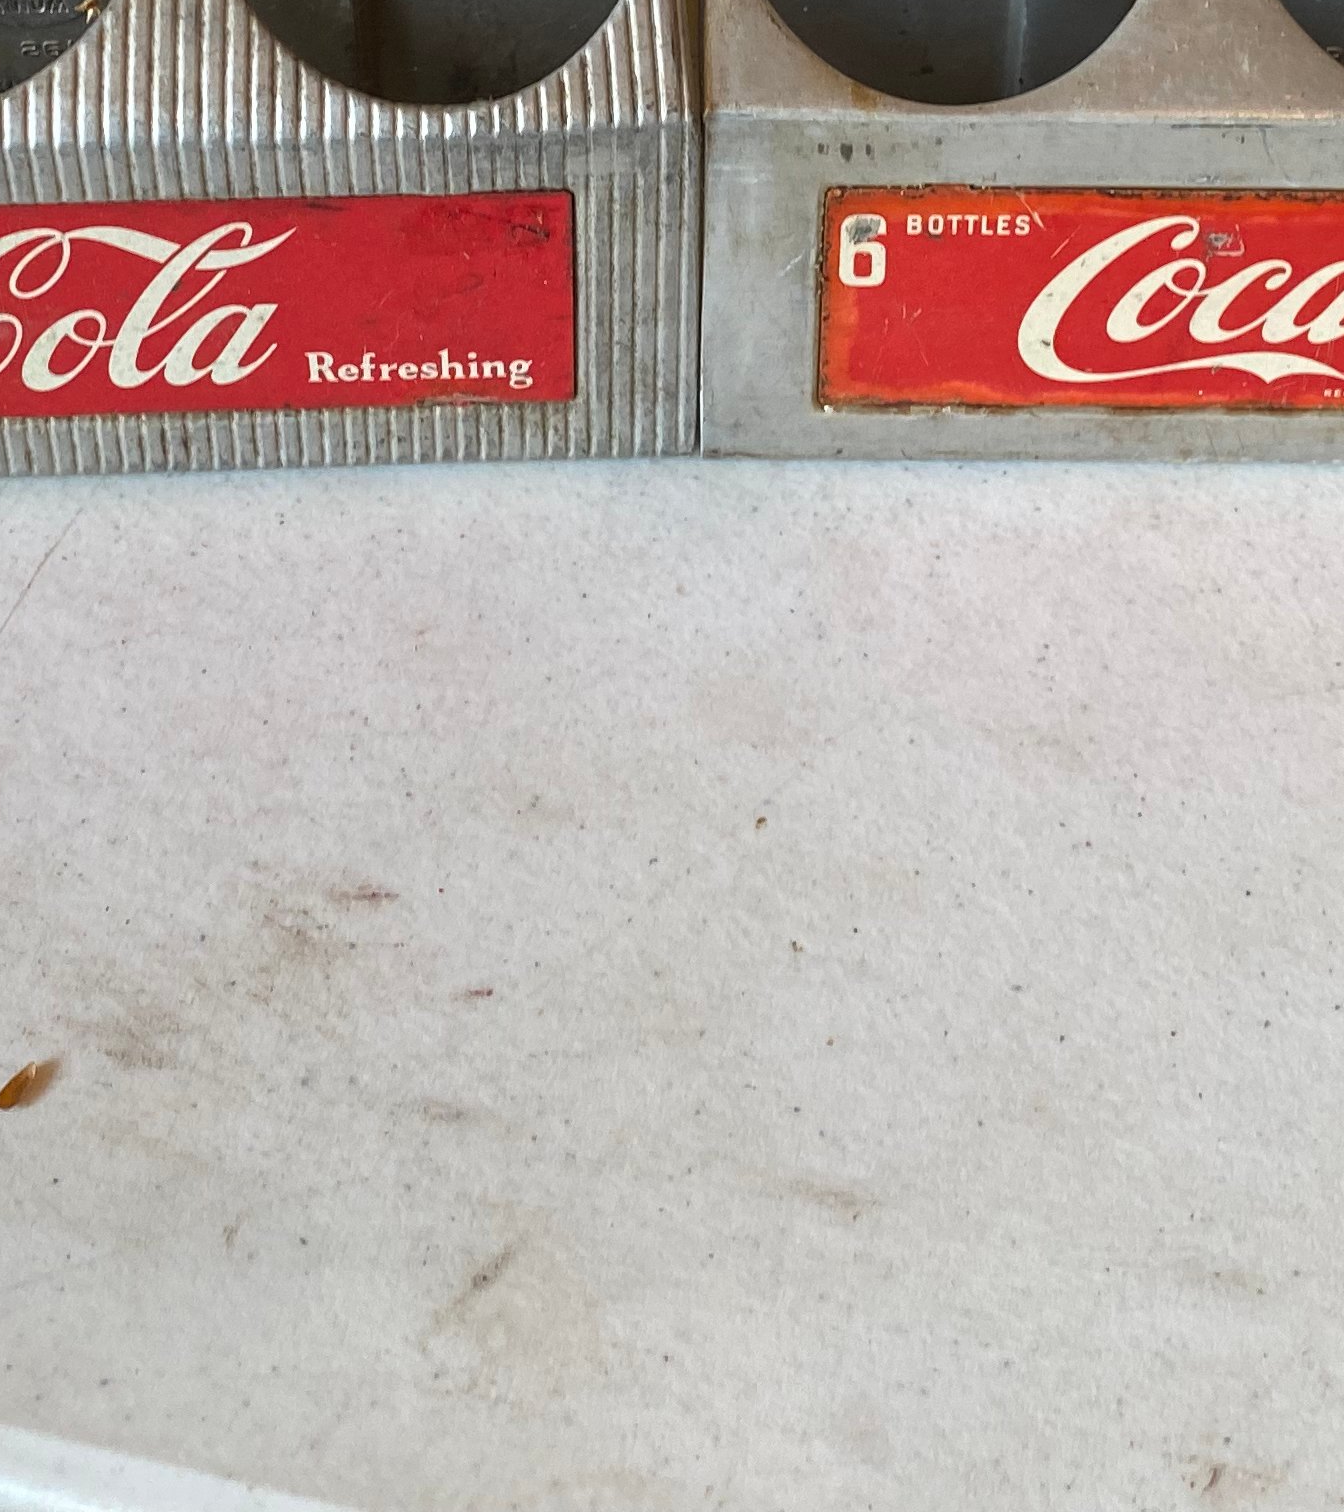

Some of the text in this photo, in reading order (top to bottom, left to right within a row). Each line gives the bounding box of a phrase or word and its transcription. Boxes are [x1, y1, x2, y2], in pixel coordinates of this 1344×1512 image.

[838, 212, 1032, 288] 6 BOTTLES
[304, 349, 534, 389] Refreshing
